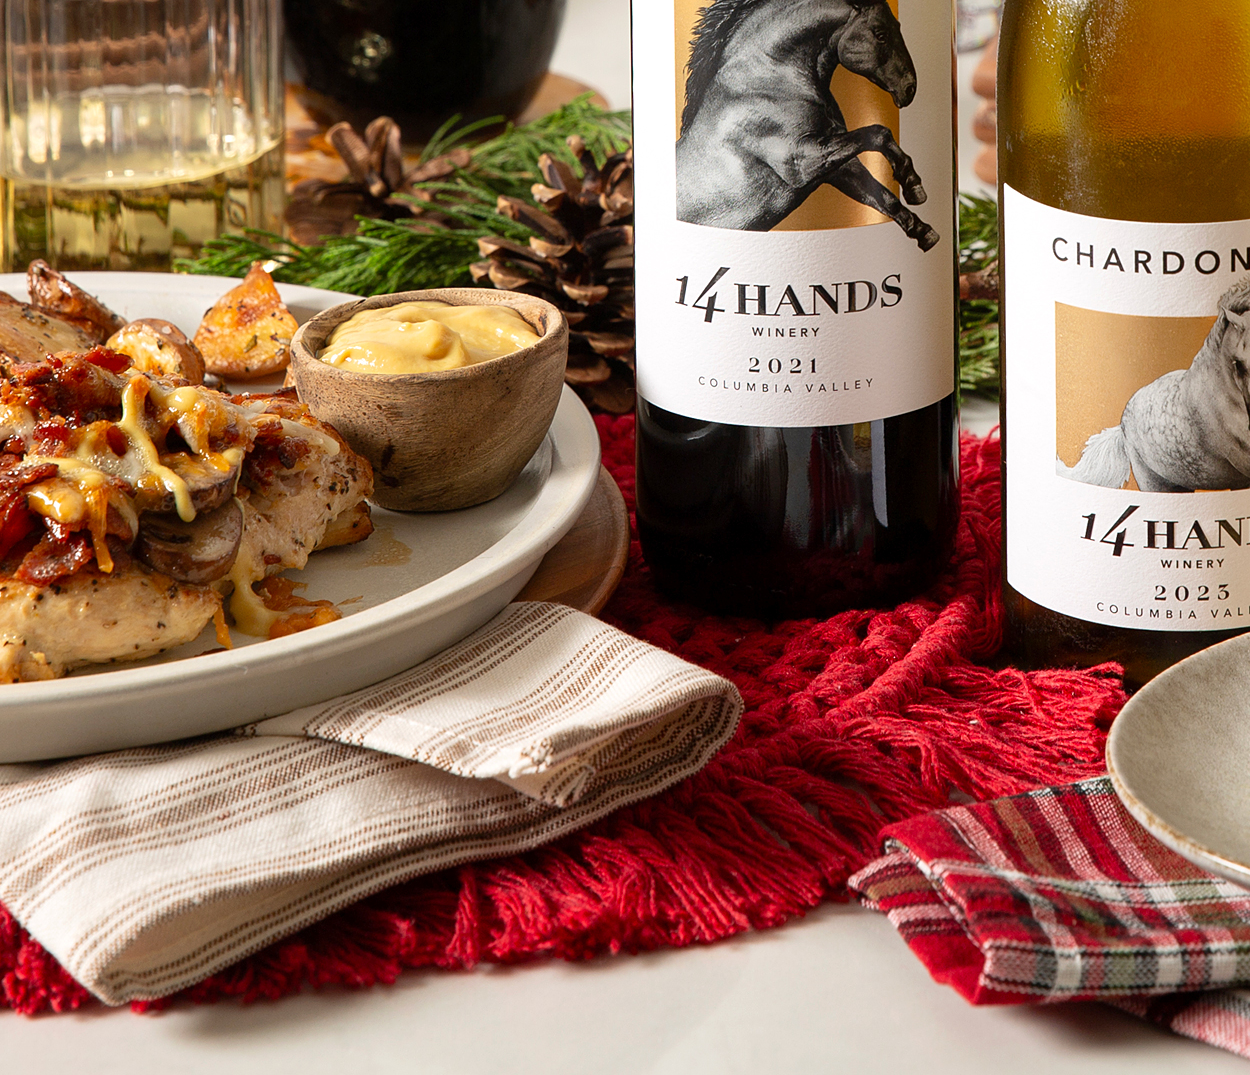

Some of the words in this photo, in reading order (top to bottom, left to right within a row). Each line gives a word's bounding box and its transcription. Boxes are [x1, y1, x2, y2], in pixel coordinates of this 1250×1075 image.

[674, 266, 731, 324] 14
[733, 273, 904, 317] HANDS
[751, 326, 820, 338] WINERY
[748, 356, 817, 374] 2021
[698, 376, 793, 394] COLUMBIA
[805, 377, 873, 393] VALLEY
[1080, 504, 1141, 558] 14
[1160, 558, 1225, 570] WINERY
[1154, 583, 1230, 602] 2023
[1096, 601, 1198, 620] COLUMBIA
